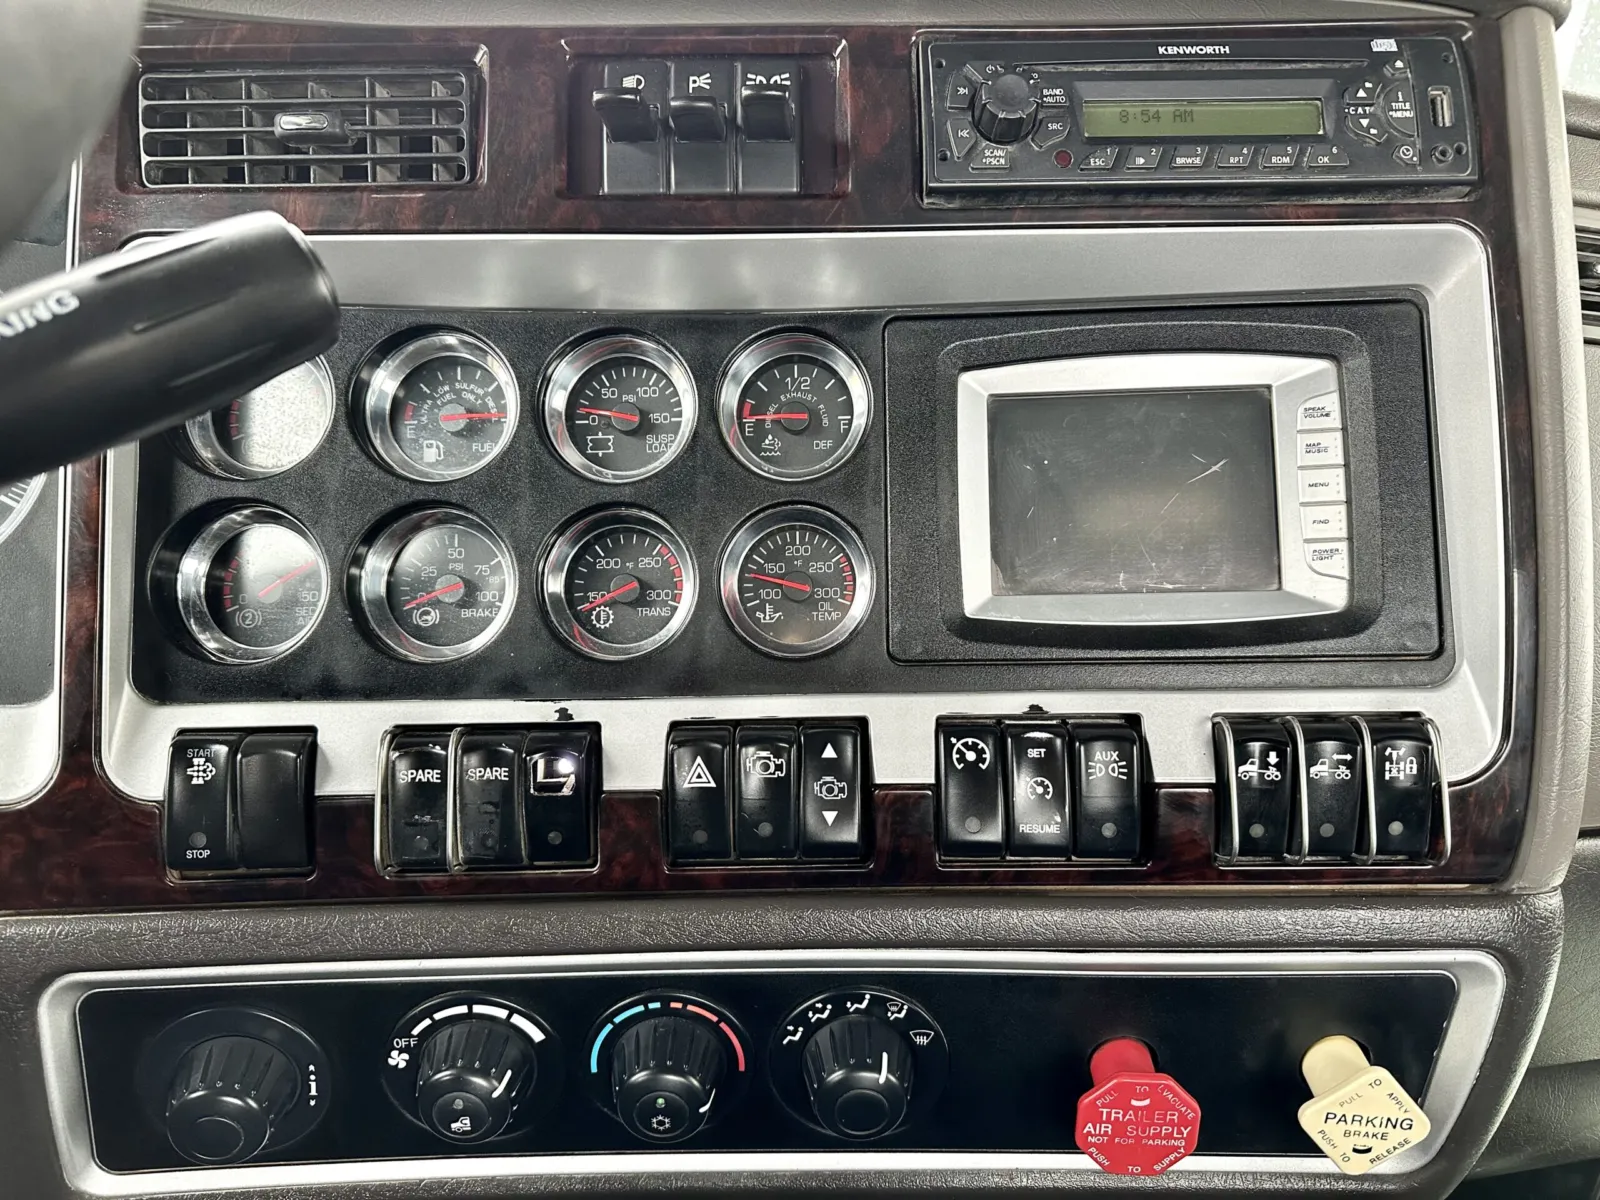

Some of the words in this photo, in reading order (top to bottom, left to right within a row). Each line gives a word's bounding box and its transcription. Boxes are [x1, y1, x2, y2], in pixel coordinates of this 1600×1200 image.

[1158, 45, 1230, 54] KENWORTH
[1042, 88, 1064, 96] BAND
[1391, 102, 1411, 110] TITLE
[1119, 109, 1161, 123] 8:54
[1173, 109, 1194, 123] AM
[1047, 123, 1064, 131] SRC
[1105, 148, 1111, 156] 1
[1150, 148, 1157, 156] 2
[1286, 146, 1293, 154] 5
[1332, 146, 1338, 154] 6
[1090, 158, 1106, 166] ESC
[1176, 156, 1202, 164] BRWSE
[1229, 156, 1244, 164] RPT
[1271, 156, 1290, 164] RDM
[1317, 156, 1330, 164] OK
[784, 376, 811, 392] 1/2
[601, 388, 618, 399] 50
[636, 386, 659, 398] 100
[420, 399, 433, 425] ULTRA
[433, 384, 450, 398] LOW
[455, 382, 485, 396] SULFUR
[436, 392, 457, 406] FUEL
[462, 391, 482, 405] ONLY
[622, 394, 637, 403] PSI
[780, 391, 818, 403] EXHAUST
[818, 404, 829, 427] FLUID
[588, 415, 599, 426] 0
[648, 412, 670, 424] 150
[406, 425, 416, 438] E
[745, 423, 754, 436] E
[840, 420, 849, 434] F
[646, 434, 675, 444] SUSP
[814, 440, 833, 450] DEF
[447, 548, 465, 559] 50
[785, 545, 811, 556] 200
[448, 562, 464, 570] PSI
[596, 558, 621, 569] 200
[638, 557, 662, 568] 250
[763, 562, 786, 574] 150
[808, 562, 834, 573] 250
[421, 566, 438, 577] 25
[474, 564, 490, 576] 75
[238, 593, 248, 604] 0
[475, 590, 499, 602] 100
[586, 591, 608, 602] 150
[646, 590, 672, 600] 300
[758, 588, 782, 600] 100
[814, 588, 840, 598] 300
[636, 607, 672, 617] TRANS
[818, 602, 834, 611] OIL
[461, 608, 499, 618] BRAKE
[812, 612, 842, 621] TEMP
[186, 748, 216, 758] START
[1026, 748, 1046, 758] SET
[1094, 750, 1120, 761] AUX
[400, 770, 442, 784] SPARE
[467, 767, 510, 782] SPARE
[1018, 824, 1061, 834] RESUME
[186, 849, 211, 859] STOP
[393, 1038, 419, 1048] OFF
[1096, 1090, 1120, 1108] PULL
[1135, 1085, 1150, 1094] TO
[1338, 1092, 1364, 1108] PULL
[1368, 1078, 1382, 1090] TO
[1386, 1092, 1411, 1114] APPLY
[1098, 1108, 1179, 1124] TRAILER
[1324, 1112, 1414, 1131] PARKING
[1082, 1122, 1112, 1136] AIR
[1126, 1124, 1192, 1138] SUPPLY
[1343, 1129, 1390, 1141] BRAKE
[1087, 1136, 1108, 1144] NOT
[1114, 1137, 1135, 1145] FOR
[1142, 1138, 1186, 1147] PARKING
[1317, 1129, 1338, 1150] PUSH
[1339, 1152, 1351, 1164] TO
[1368, 1137, 1412, 1165] RELEASE
[1088, 1146, 1111, 1167] PUSH
[1127, 1166, 1142, 1174] TO
[1153, 1146, 1186, 1172] SUPPLY
